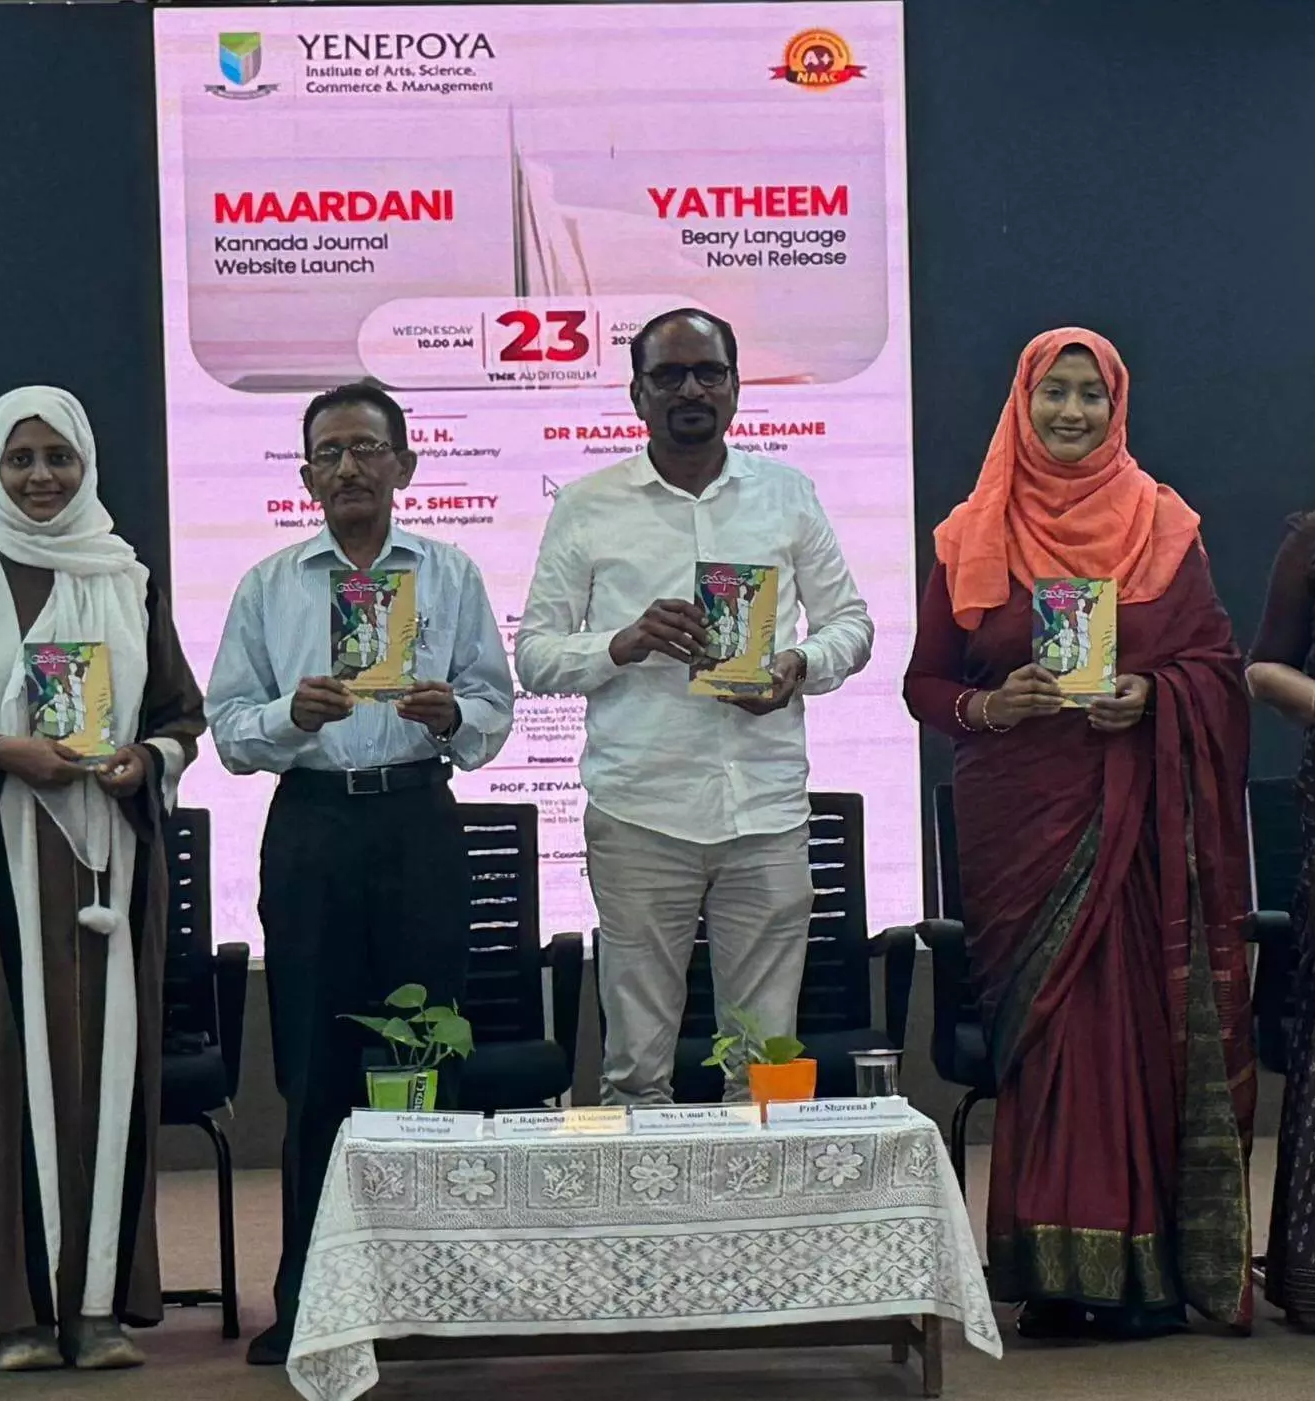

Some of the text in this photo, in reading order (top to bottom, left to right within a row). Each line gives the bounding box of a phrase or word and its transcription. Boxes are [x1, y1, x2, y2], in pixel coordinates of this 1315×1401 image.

[298, 32, 496, 60] YENEPOYA
[803, 50, 832, 66] A+
[305, 64, 362, 78] Institute
[365, 63, 380, 78] of
[796, 71, 837, 83] NAAC
[305, 80, 494, 96] Commerce & Management
[214, 189, 454, 224] MAARDANI
[647, 184, 849, 219] YATHEEM
[214, 232, 389, 252] Kannada Journal
[681, 228, 847, 249] Beary Language
[214, 255, 375, 276] Website Launch
[707, 249, 847, 268] Novel Release
[392, 325, 474, 337] WEDNESDAY
[495, 310, 590, 362] 23
[453, 337, 474, 348] AM
[519, 369, 598, 381] AUDITORIUM
[410, 427, 454, 443] U. H.
[544, 426, 571, 440] DR
[267, 500, 294, 513] DR
[405, 496, 423, 510] P.
[427, 494, 499, 509] SHETTY
